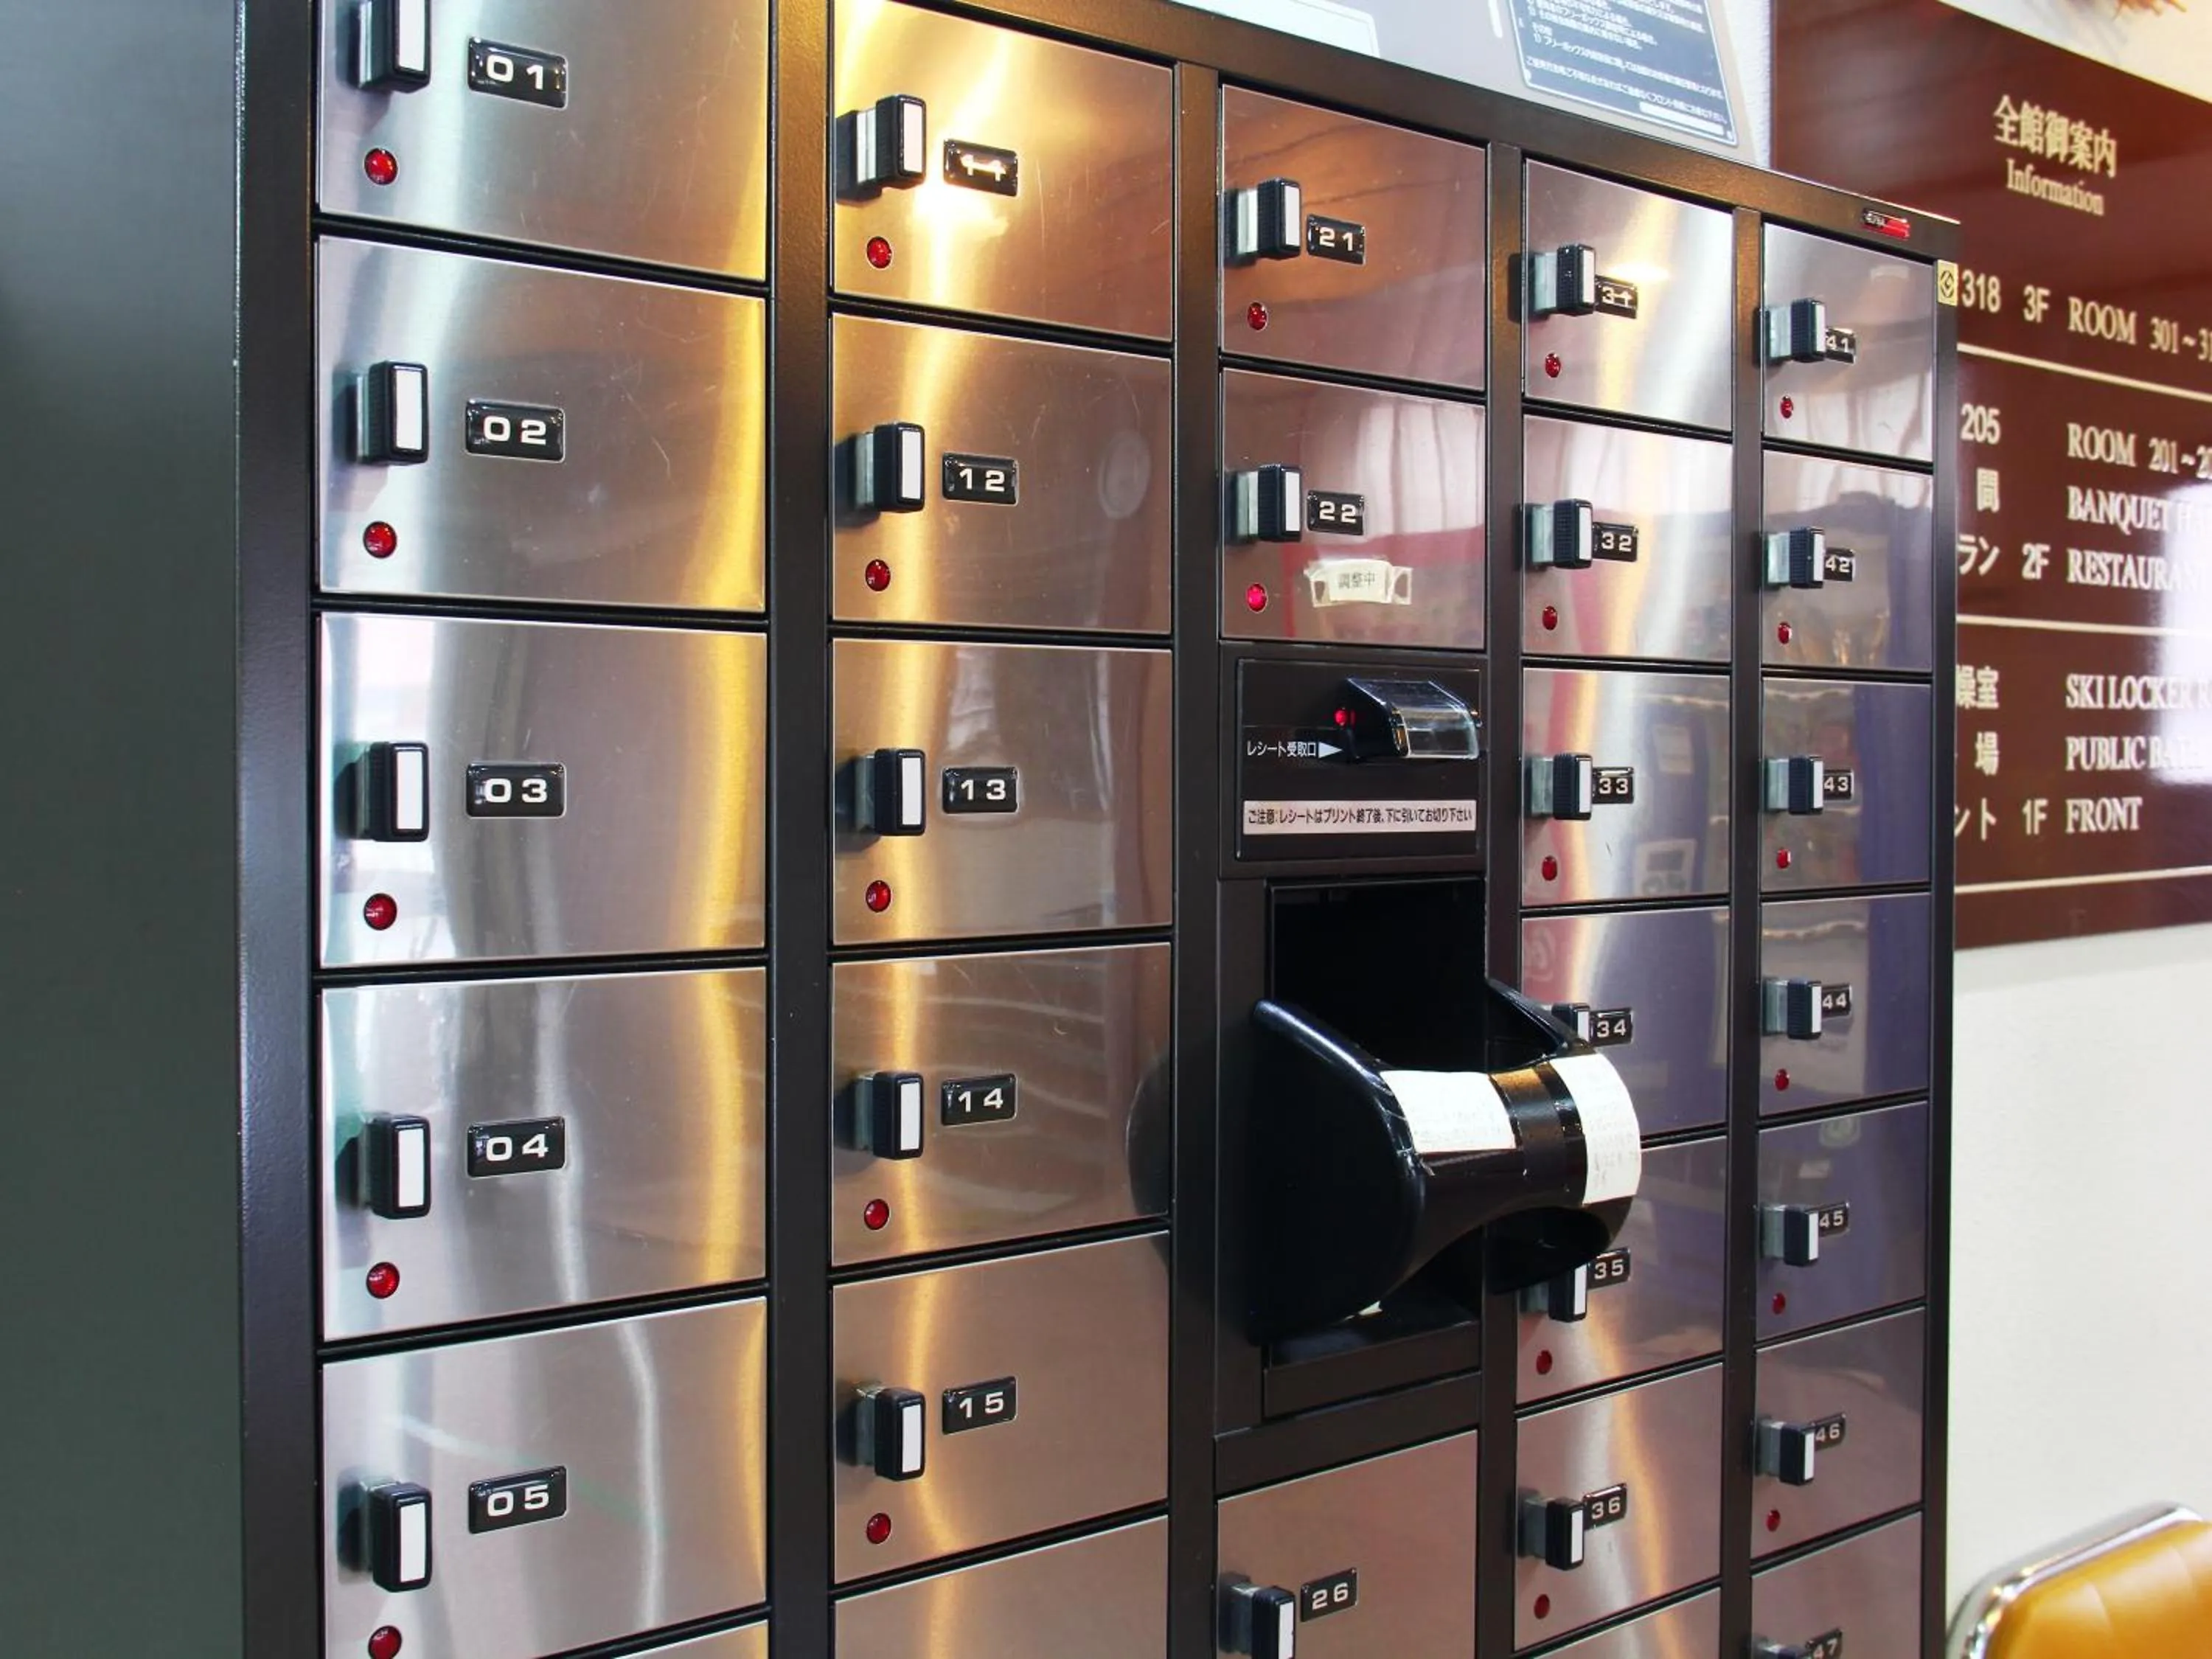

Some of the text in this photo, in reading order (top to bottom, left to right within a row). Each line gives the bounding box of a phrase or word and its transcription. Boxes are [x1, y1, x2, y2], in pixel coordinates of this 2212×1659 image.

[487, 55, 543, 89] 01
[1994, 94, 2118, 179] 全館御案内
[2006, 158, 2105, 216] Information
[1319, 226, 1353, 251] 21
[1961, 270, 2001, 313] 318
[2023, 285, 2051, 322] 3F
[2067, 297, 2137, 344] ROOM
[1826, 335, 1848, 352] 41
[483, 416, 546, 445] 02
[1961, 403, 2000, 444] 205
[2067, 423, 2136, 467] ROOM
[959, 468, 1004, 492] 12
[1319, 501, 1355, 524] 22
[2067, 485, 2169, 535] BANQUET
[1601, 532, 1631, 552] 32
[1825, 555, 1850, 573] 42
[1957, 534, 2000, 576] ラン
[2022, 543, 2051, 580] 2F
[2066, 674, 2104, 709] SKI
[2108, 675, 2194, 710] LOCKER
[1247, 741, 1316, 757] レシート受取口
[1975, 732, 1999, 776] 場
[2066, 737, 2146, 771] PUBLIC
[484, 778, 548, 803] 03
[961, 779, 1006, 800] 13
[1599, 778, 1628, 794] 33
[1823, 776, 1848, 791] 43
[2022, 799, 2048, 835] 1F
[2066, 797, 2143, 833] FRONT
[1822, 993, 1846, 1008] 44
[1596, 1018, 1626, 1037] 34
[959, 1088, 1004, 1112] 14
[486, 1133, 549, 1161] 04
[1819, 1211, 1843, 1227] 45
[1594, 1259, 1624, 1279] 35
[959, 1392, 1004, 1418] 15
[1815, 1424, 1840, 1441] 46
[487, 1484, 549, 1517] 05
[1591, 1497, 1620, 1519] 36
[1312, 1583, 1348, 1610] 26
[1814, 1638, 1837, 1659] 47
